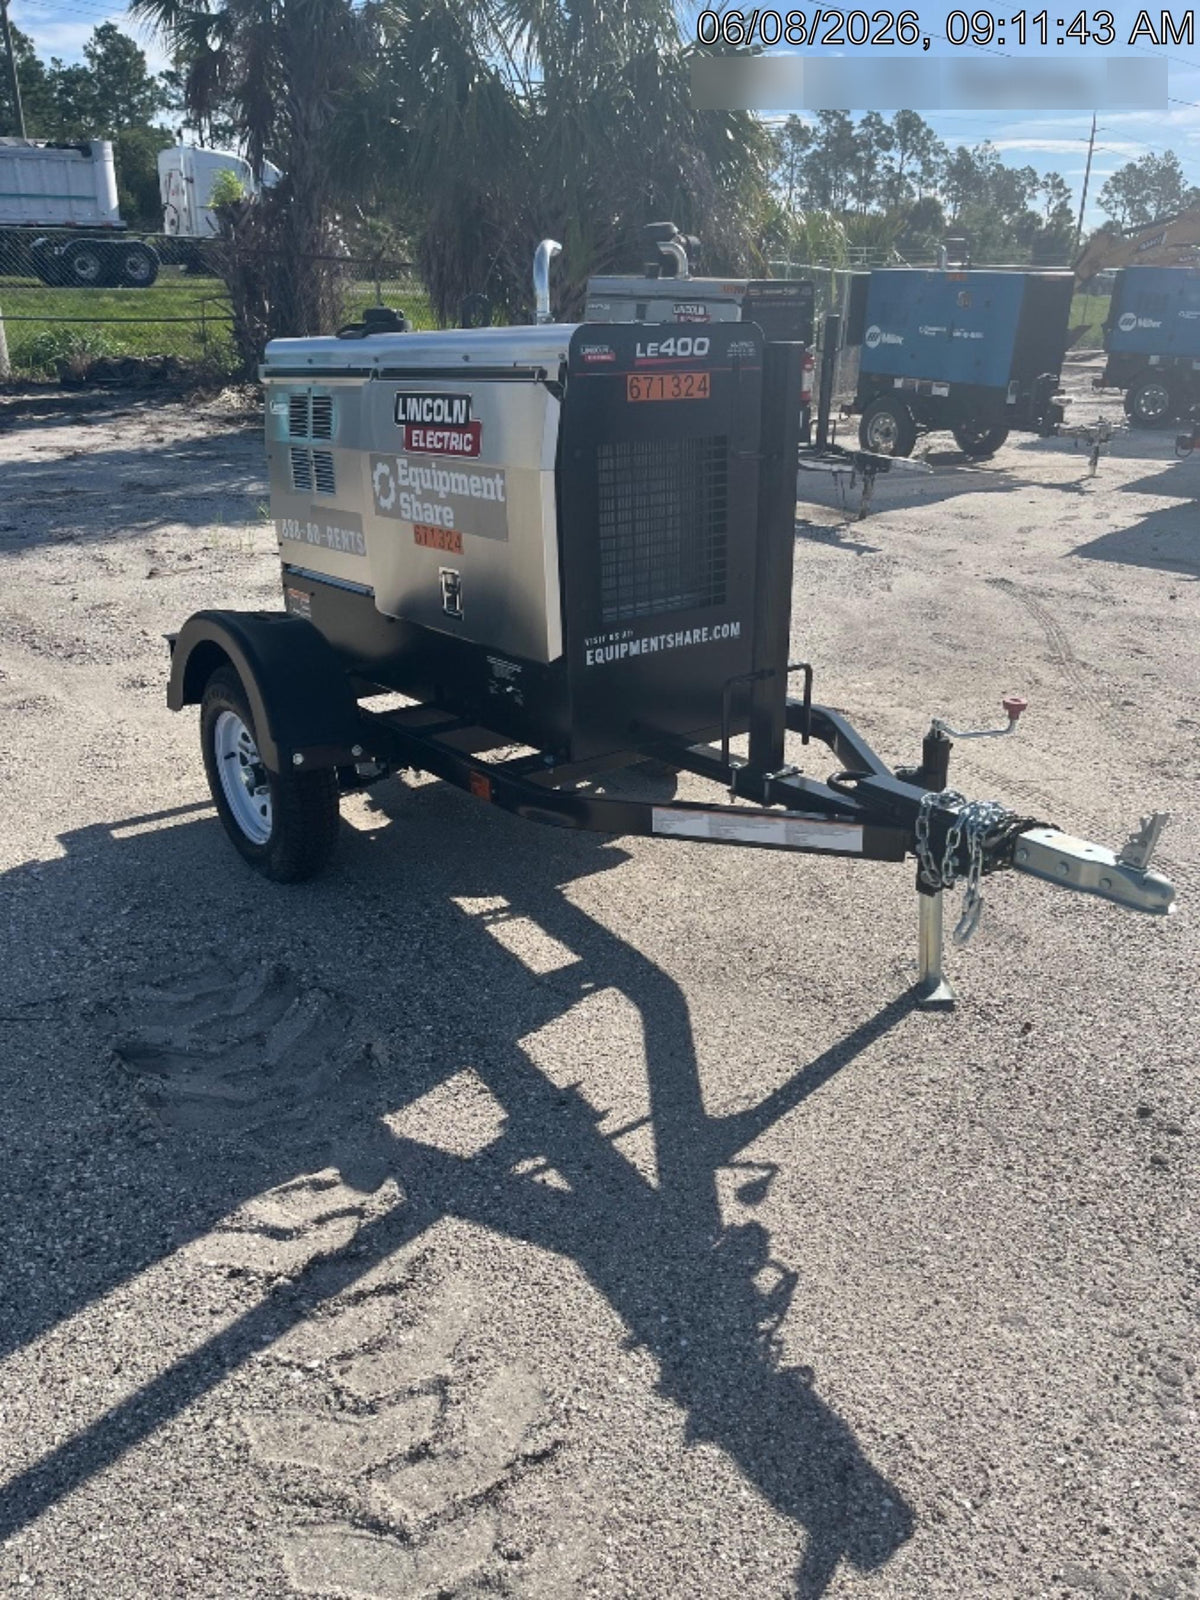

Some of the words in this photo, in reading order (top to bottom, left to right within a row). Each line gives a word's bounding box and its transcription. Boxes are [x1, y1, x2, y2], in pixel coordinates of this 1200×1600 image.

[635, 337, 710, 357] LE400
[628, 374, 709, 401] 671324
[397, 397, 467, 424] LINCOLN
[411, 429, 473, 452] ELECTRIC
[396, 458, 506, 502] Equipment
[400, 492, 455, 528] Share
[414, 524, 463, 551] 671324
[586, 621, 741, 666] EQUIPMENTSHARE.COM
